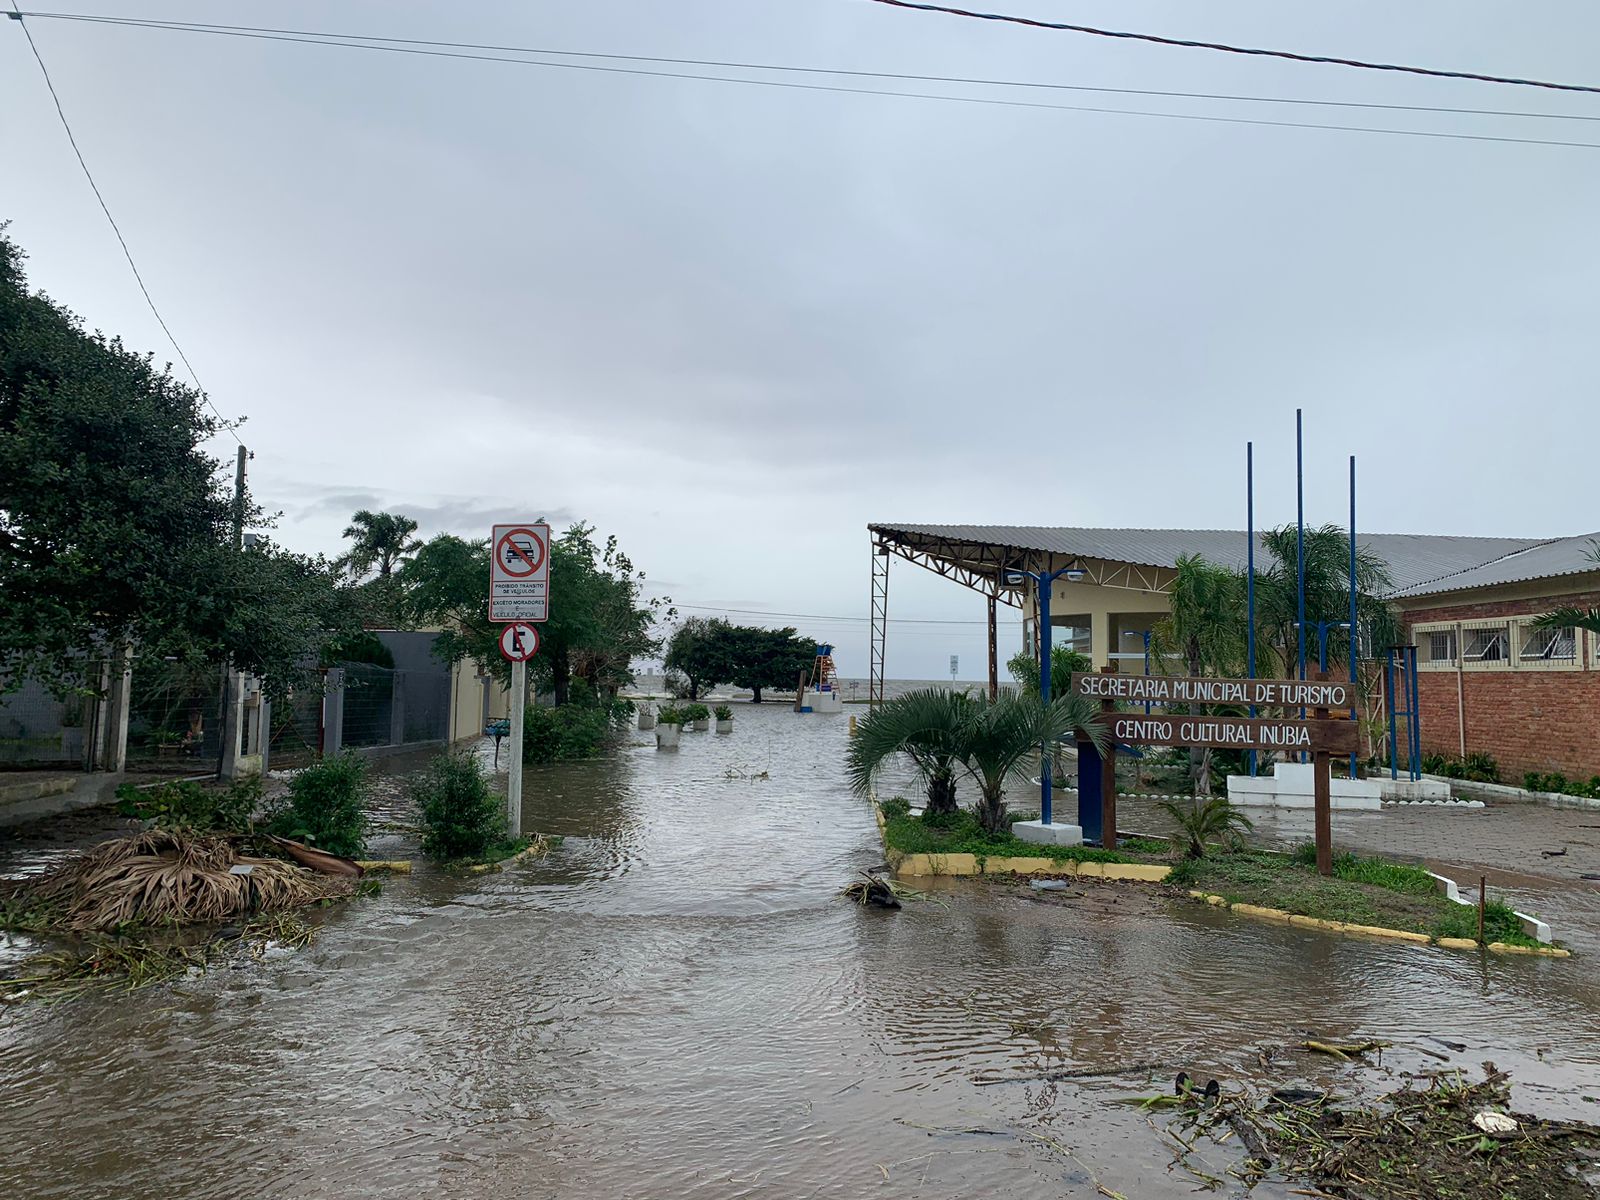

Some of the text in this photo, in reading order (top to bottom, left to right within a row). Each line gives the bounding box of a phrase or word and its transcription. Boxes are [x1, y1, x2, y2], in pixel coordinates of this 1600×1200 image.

[1080, 676, 1347, 705] SECRETARIA MUNICIPAL DE TURISMO
[1115, 719, 1311, 745] CENTRO CULTURAL INÚBIA
